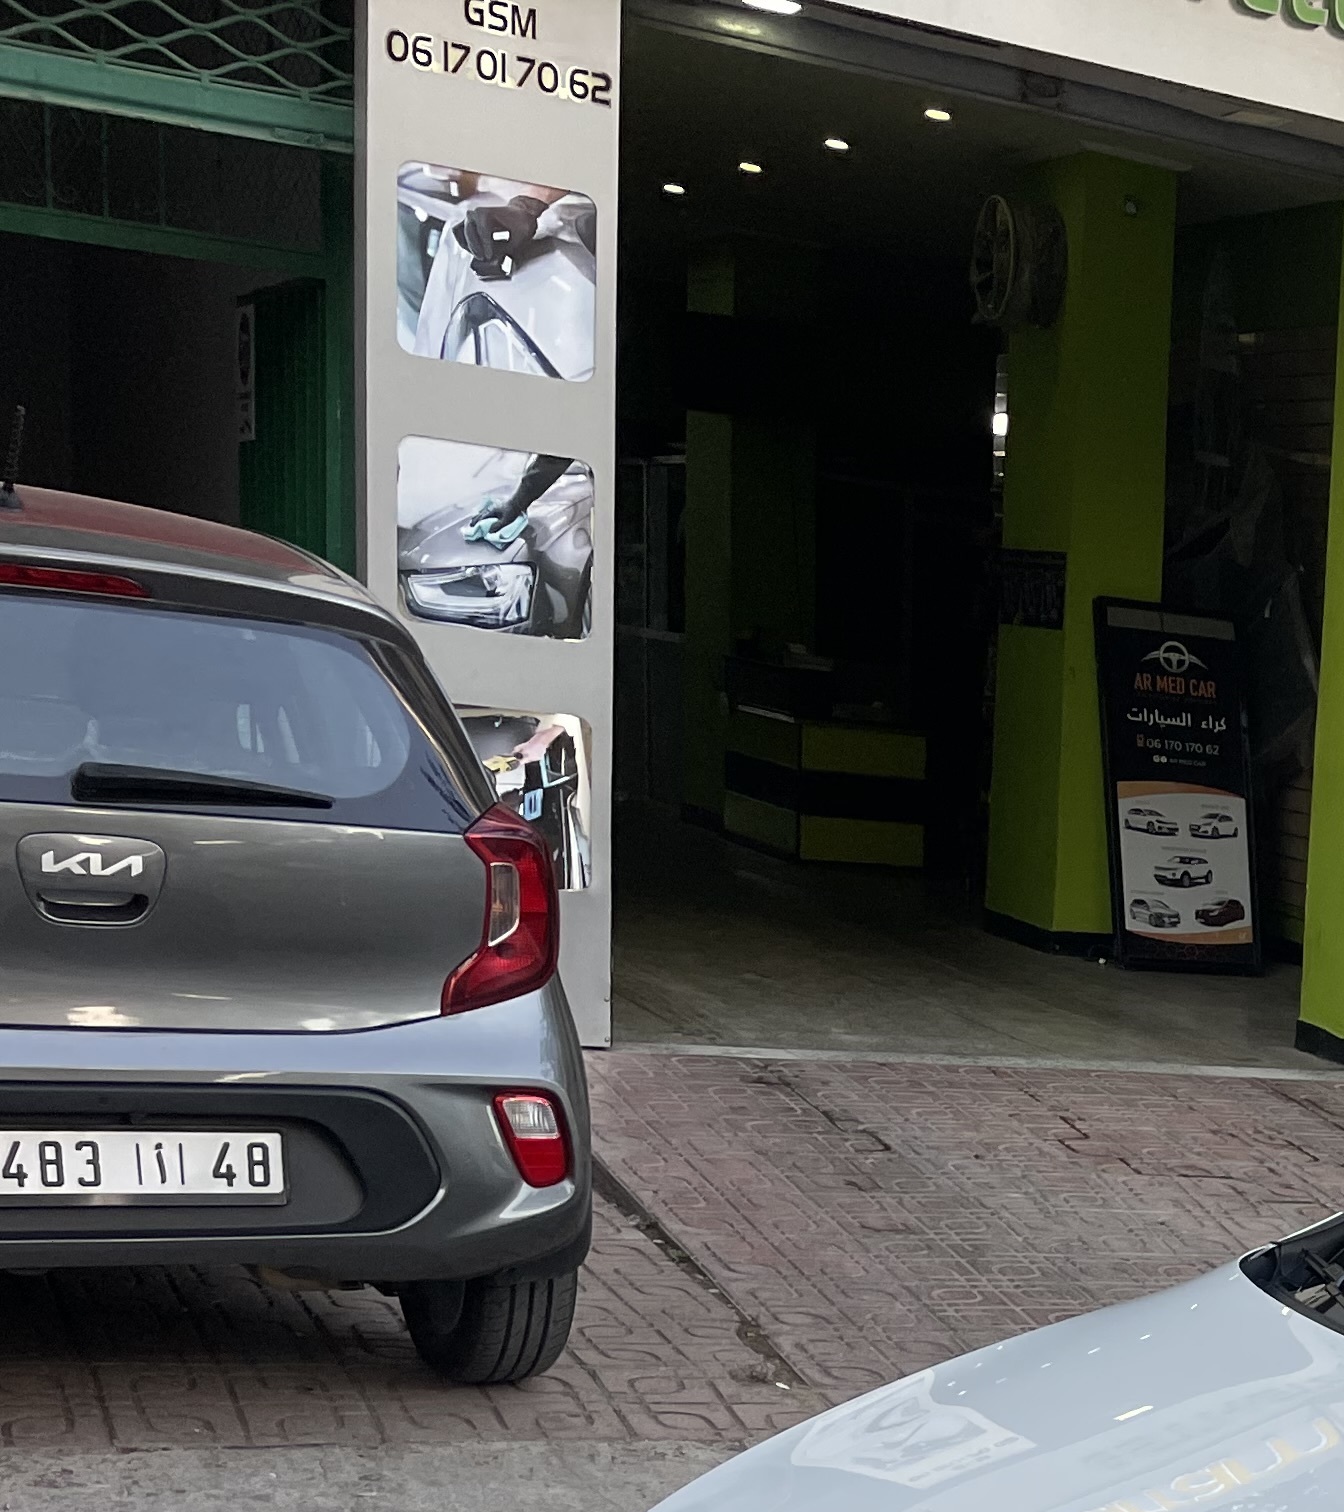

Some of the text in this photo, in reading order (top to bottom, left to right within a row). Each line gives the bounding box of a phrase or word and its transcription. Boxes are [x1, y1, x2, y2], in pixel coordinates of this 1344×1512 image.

[464, 0, 537, 40] GSM
[1134, 672, 1217, 698] AR MED CAR
[1126, 707, 1227, 733] كراء السيارات
[42, 850, 143, 877] KIA
[2, 1140, 102, 1187] 483
[212, 1141, 271, 1187] 48
